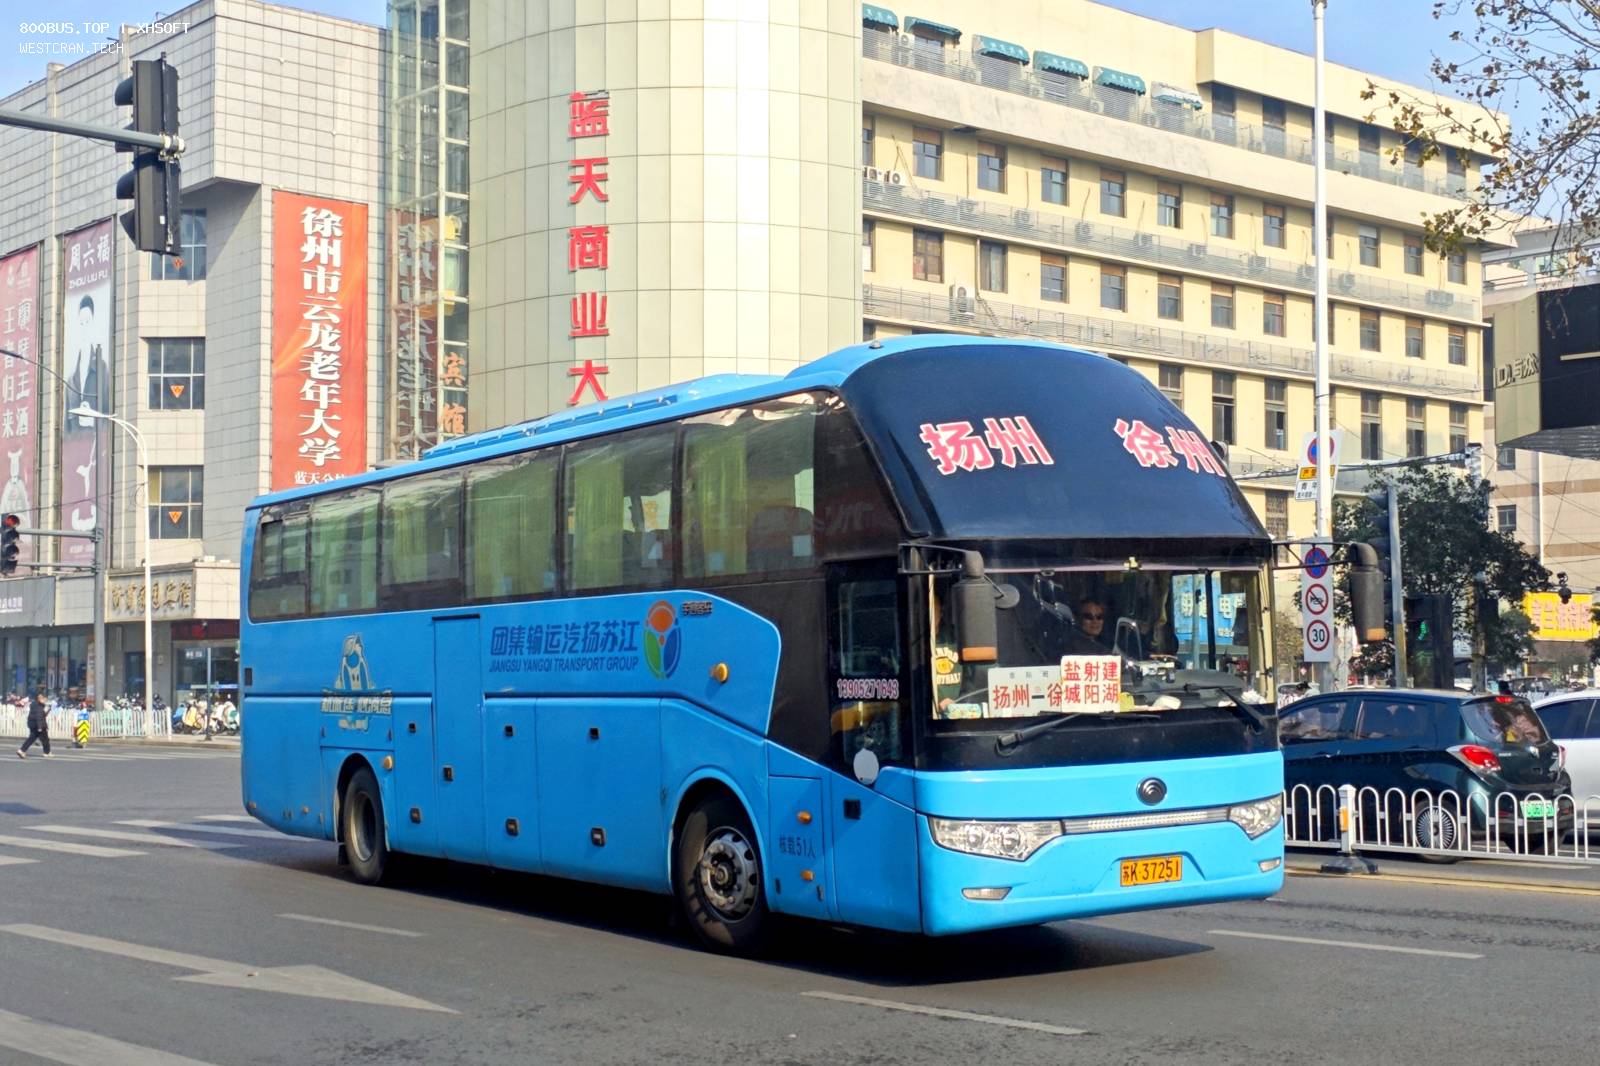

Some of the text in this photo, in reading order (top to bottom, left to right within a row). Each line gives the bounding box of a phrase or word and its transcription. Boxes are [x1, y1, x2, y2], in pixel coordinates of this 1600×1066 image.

[69, 233, 110, 272] 周六福
[69, 276, 87, 289] ZHOU
[298, 206, 343, 466] 徐州市云龙老年大学
[2, 306, 16, 438] 王者归来
[440, 351, 466, 434] 宾馆
[919, 416, 1227, 477] 扬州 徐州
[1312, 628, 1325, 642] 30
[489, 656, 640, 673] JIANGSU YANGQI TRANSPORT GROUP
